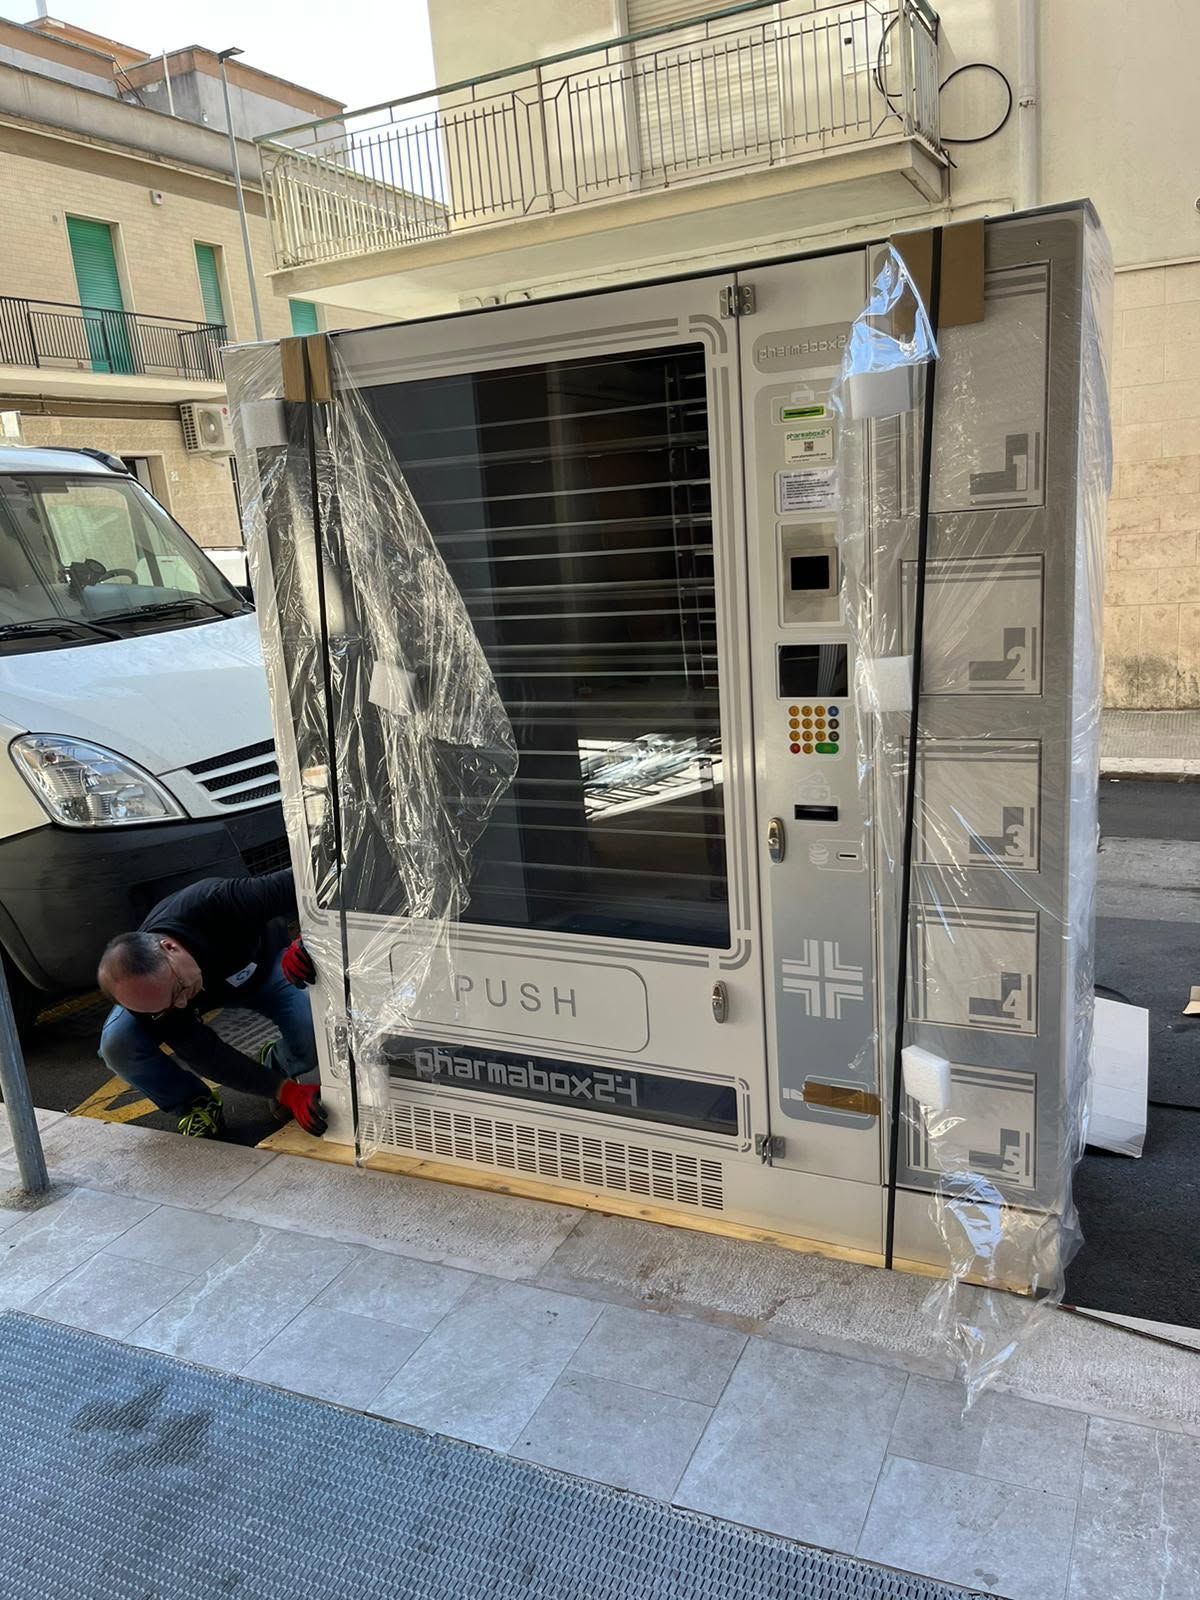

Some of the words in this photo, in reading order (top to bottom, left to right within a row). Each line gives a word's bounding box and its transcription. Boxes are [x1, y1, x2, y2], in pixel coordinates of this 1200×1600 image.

[1012, 453, 1027, 491] 1
[1005, 646, 1026, 680] 2
[1004, 824, 1026, 856] 3
[454, 974, 577, 1018] PUSH
[1002, 989, 1023, 1018] 4
[415, 1048, 639, 1107] pharmabox24
[1002, 1145, 1022, 1173] 5
